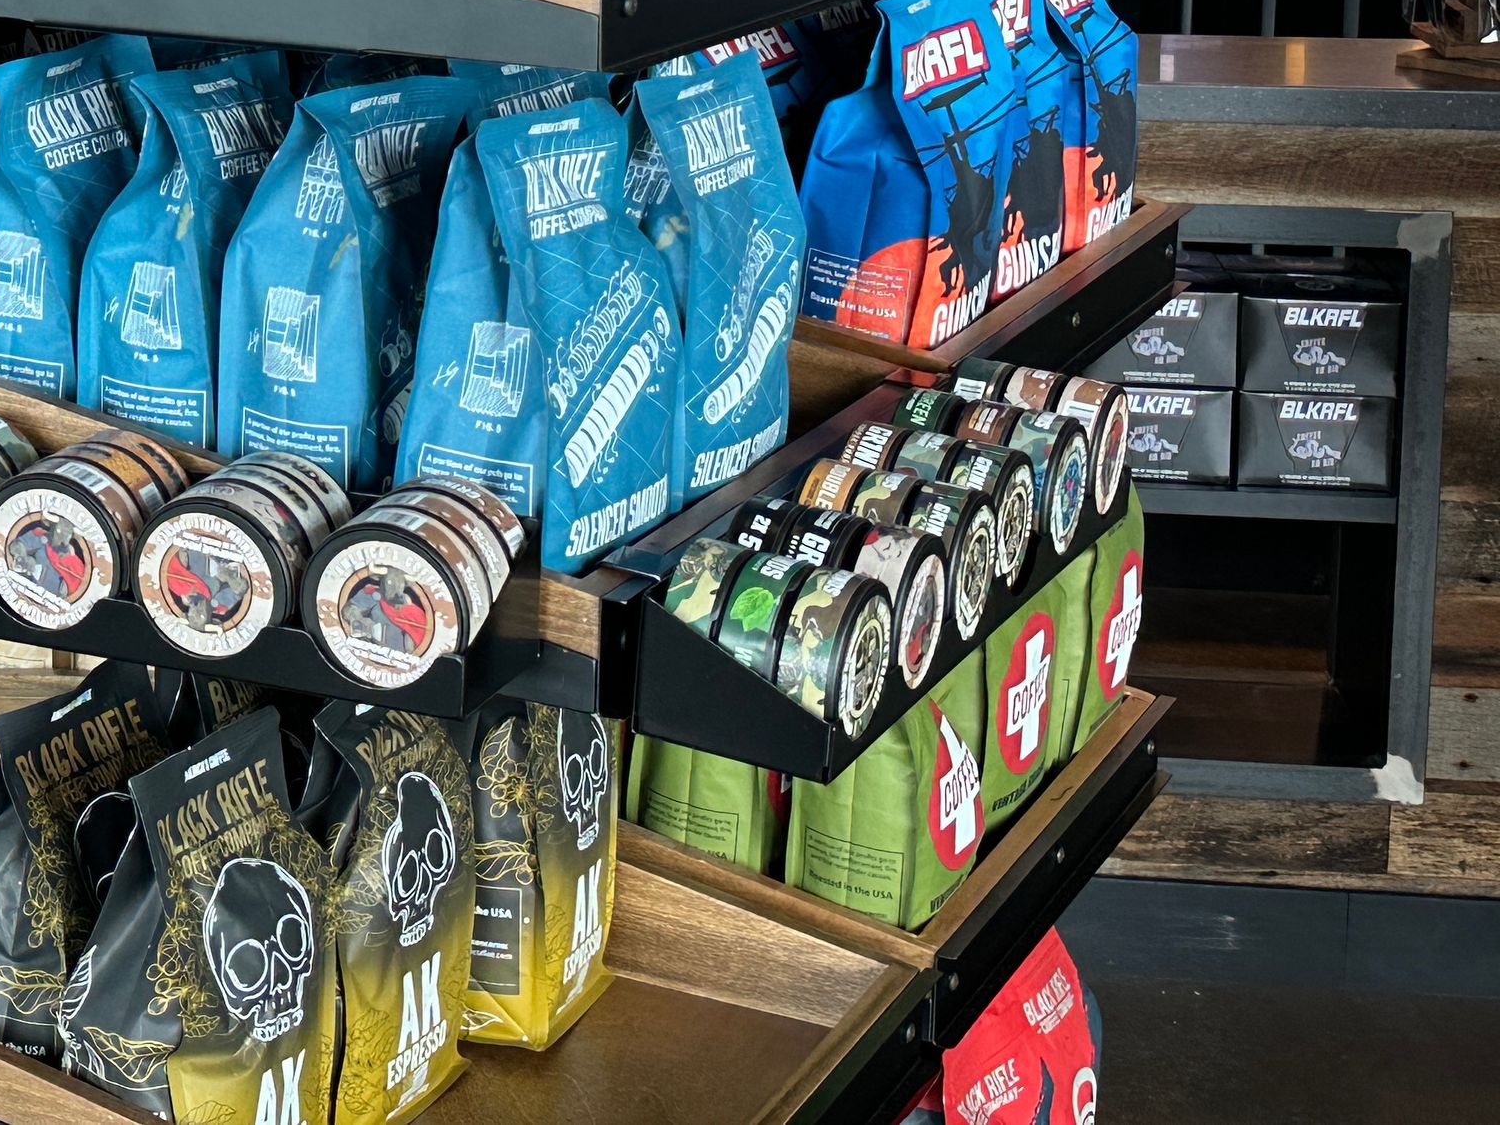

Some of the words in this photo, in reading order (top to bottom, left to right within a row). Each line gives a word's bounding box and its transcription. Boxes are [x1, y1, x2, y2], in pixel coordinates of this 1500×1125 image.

[27, 91, 87, 148] BLACK
[44, 140, 92, 170] COFFEE
[220, 152, 258, 180] COFFEE
[694, 168, 728, 196] COFFEE
[876, 308, 897, 318] USA
[690, 439, 750, 488] SILENCER
[565, 502, 628, 558] SILENCER
[628, 473, 669, 532] SMOOTH
[15, 728, 88, 799] BLACK
[81, 698, 149, 761] RIFLE
[157, 790, 218, 862] BLACK
[216, 758, 273, 825] RIFLE
[491, 907, 512, 919] USA
[572, 859, 602, 950] AK
[854, 884, 870, 896] the
[872, 888, 893, 900] USA
[398, 951, 441, 1055] AK
[25, 1044, 47, 1057] USA
[387, 1020, 447, 1091] ESPRESSO
[254, 1048, 306, 1125] AK
[984, 1059, 1020, 1099] RIFLE
